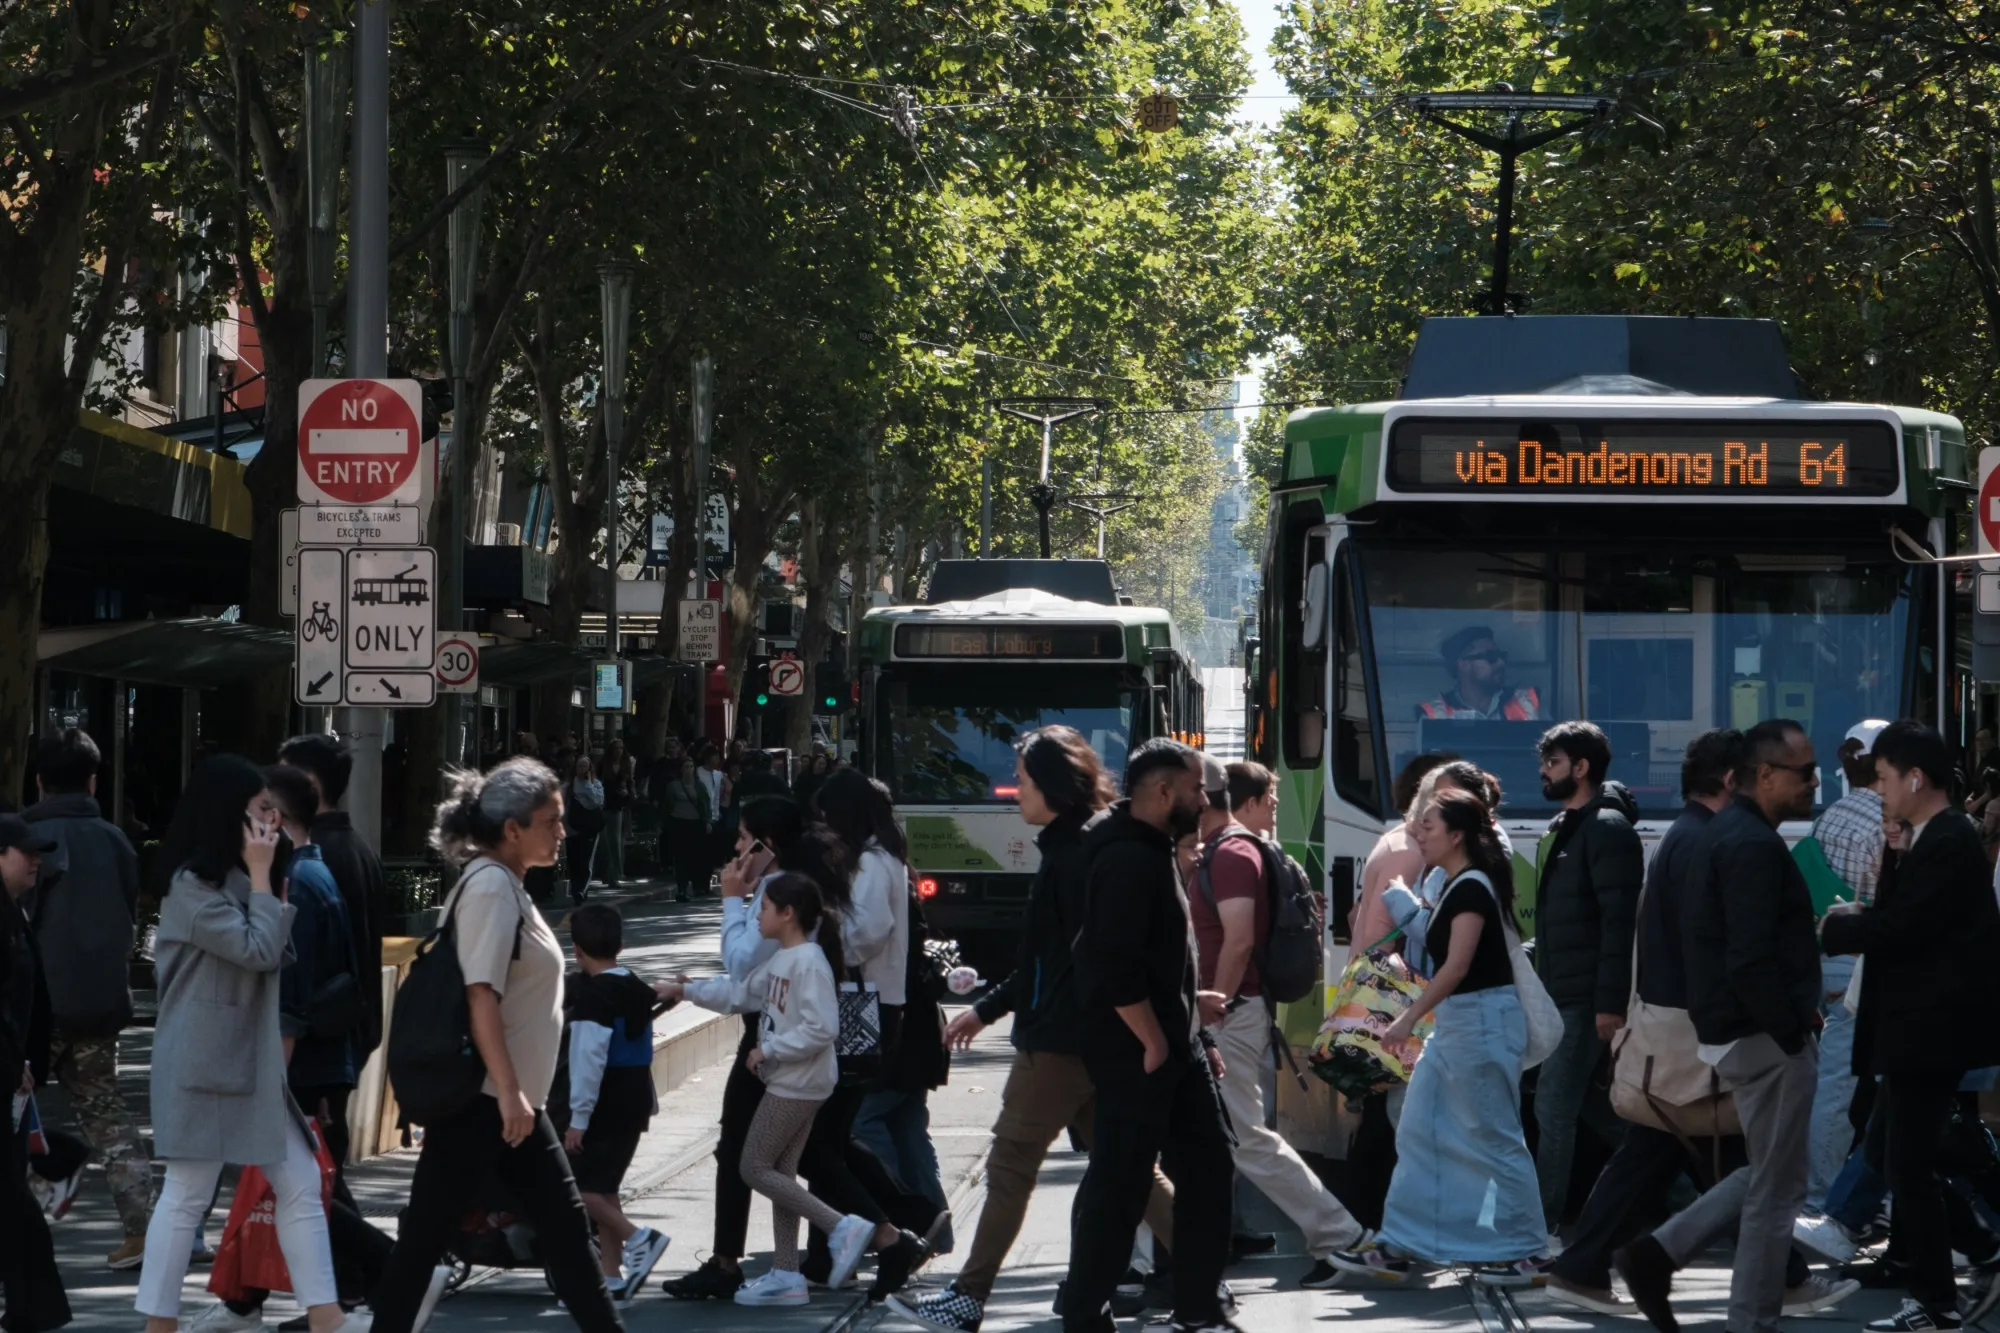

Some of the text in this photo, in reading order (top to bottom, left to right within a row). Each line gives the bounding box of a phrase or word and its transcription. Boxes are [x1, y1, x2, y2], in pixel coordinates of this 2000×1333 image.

[1143, 101, 1172, 114] CUT
[1144, 115, 1171, 127] OFF
[341, 398, 378, 421] NO
[317, 461, 401, 484] ENTRY
[1456, 441, 1846, 484] via Dandenong Rd 64
[317, 512, 402, 523] BICYCLES & TRAMS
[336, 527, 382, 538] EXCEPTED
[355, 625, 425, 652] ONLY
[690, 634, 709, 642] STOP
[950, 635, 1101, 655] East Coburg 1
[441, 652, 470, 672] 30
